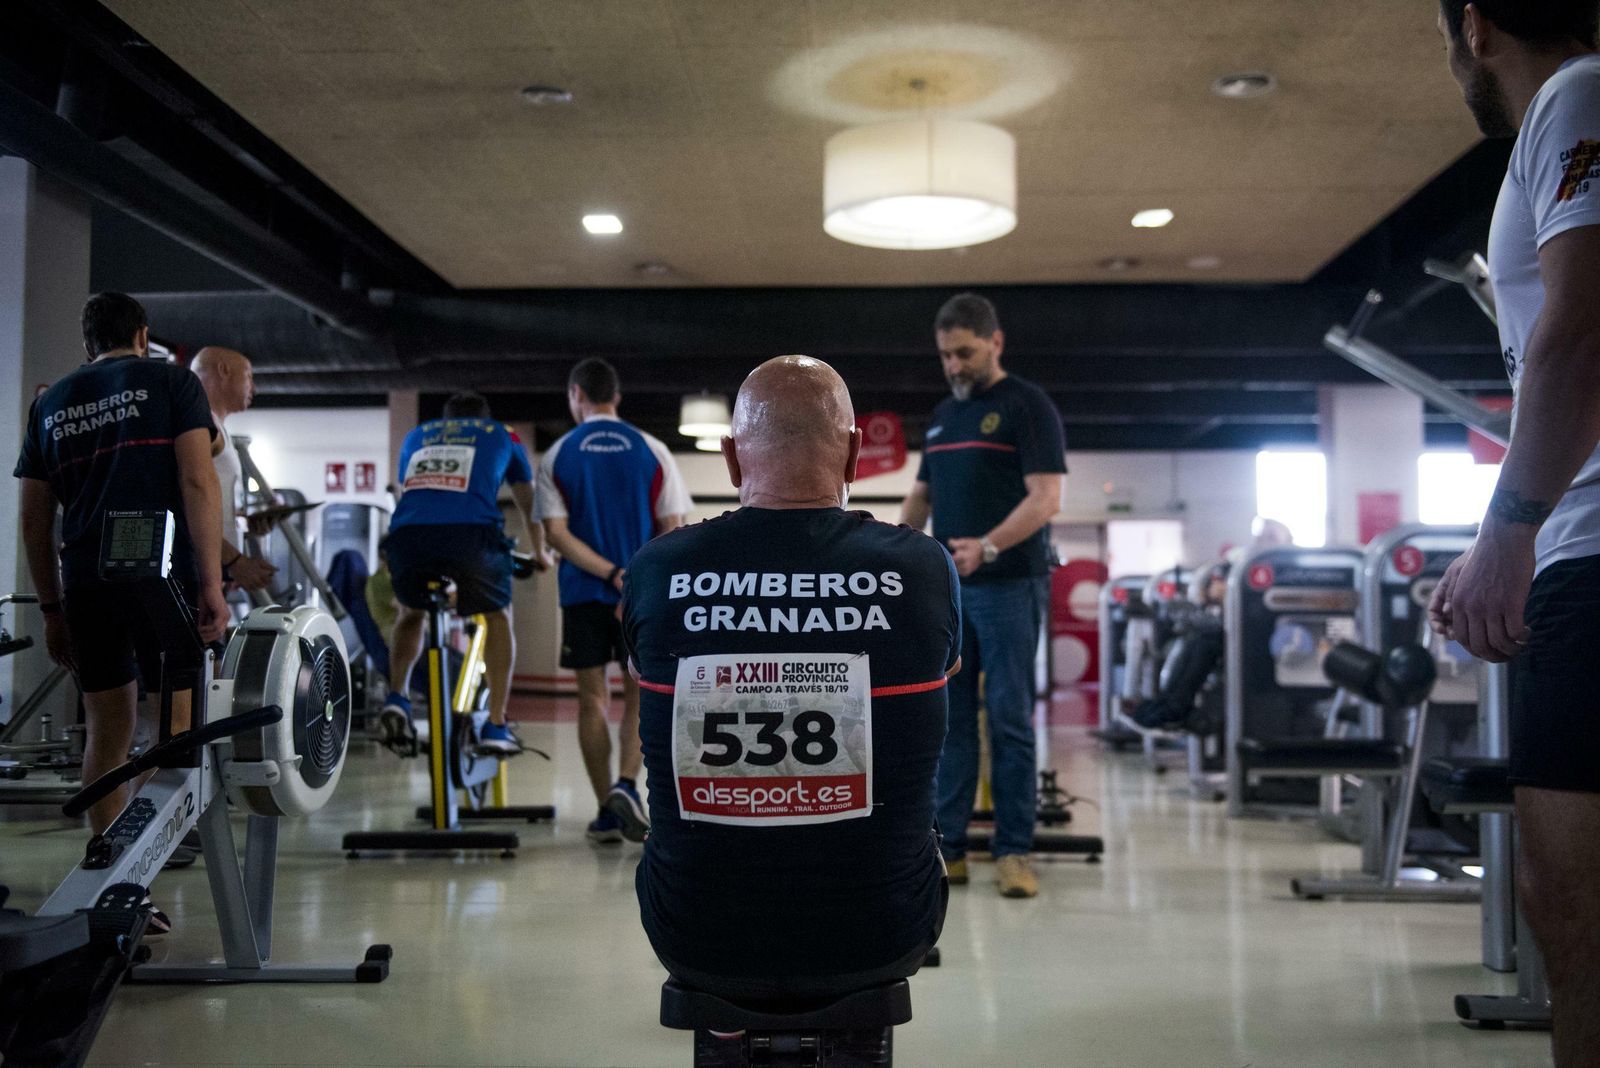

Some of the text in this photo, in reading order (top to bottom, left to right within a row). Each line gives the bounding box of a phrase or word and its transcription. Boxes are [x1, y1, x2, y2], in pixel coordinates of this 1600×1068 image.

[44, 389, 148, 430] BOMBEROS
[52, 404, 140, 440] GRANADA
[415, 458, 460, 474] 539
[668, 571, 904, 600] BOMBEROS
[683, 605, 892, 633] GRANADA
[736, 662, 849, 683] XXIII CIRCUITO
[782, 674, 849, 683] PROVINCIAL
[736, 685, 773, 694] CAMPO
[775, 685, 783, 693] A
[785, 682, 822, 693] TRAVÉS
[824, 684, 849, 694] 18/19
[699, 710, 838, 767] 538
[692, 780, 853, 813] alssport.es
[757, 806, 789, 814] RUNNING
[819, 802, 852, 812] OUTDOOR
